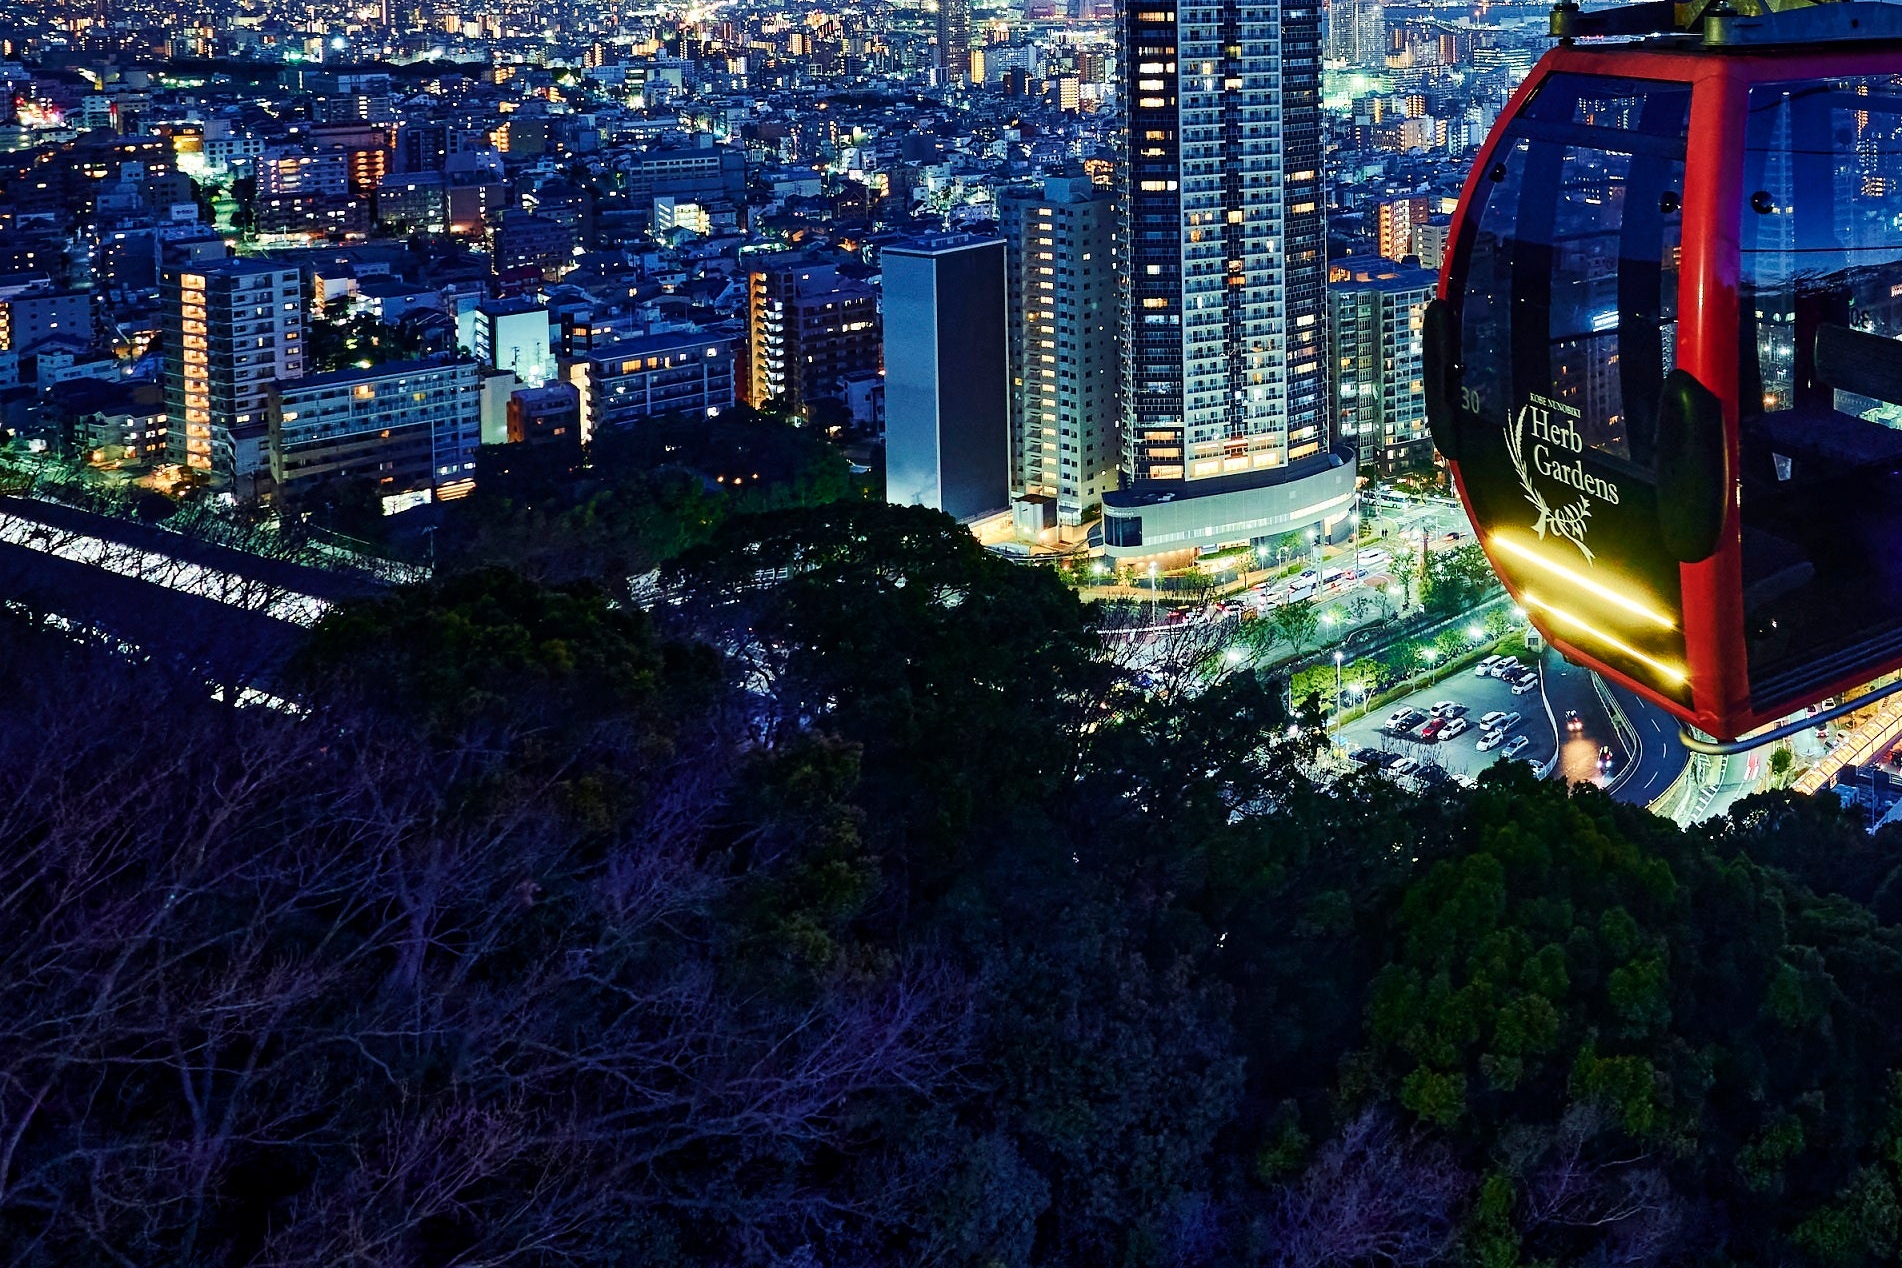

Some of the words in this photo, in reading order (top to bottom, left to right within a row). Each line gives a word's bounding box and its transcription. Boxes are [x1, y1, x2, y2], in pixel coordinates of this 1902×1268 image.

[1461, 385, 1480, 414] 30
[1529, 405, 1583, 454] Herb
[1533, 443, 1620, 506] Gardens
